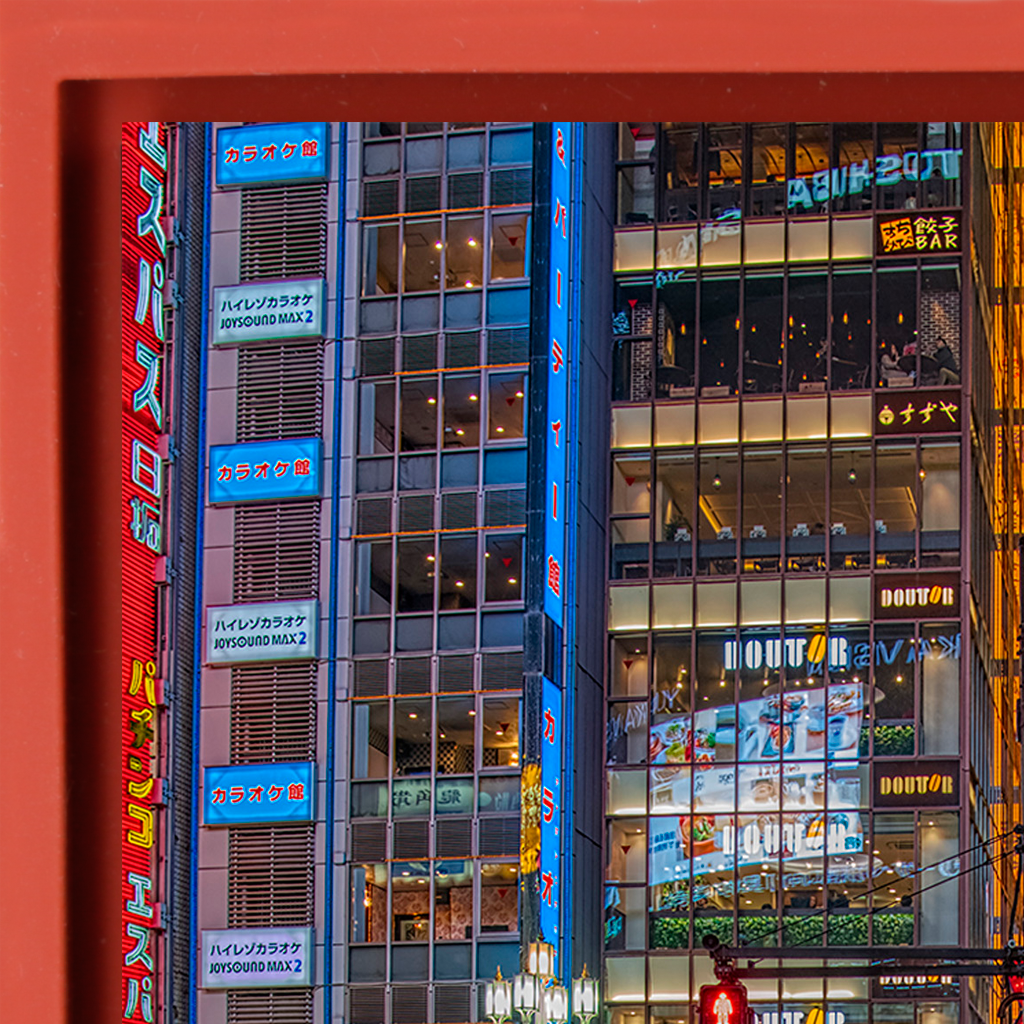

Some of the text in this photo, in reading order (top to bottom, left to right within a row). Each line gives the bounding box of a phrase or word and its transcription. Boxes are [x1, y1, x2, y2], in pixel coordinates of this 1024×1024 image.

[224, 140, 319, 164] カラオケ館
[913, 216, 959, 235] 餃子
[915, 233, 958, 250] BAR
[220, 294, 313, 312] ハイレゾカラオケ
[219, 313, 276, 330] JOYSOUND
[899, 401, 959, 425] すずや
[217, 458, 311, 482] カラオケ館
[880, 584, 954, 608] DOUTOR
[213, 614, 307, 632] ハイレゾカラオケ
[213, 634, 270, 651] JOYSOUND
[724, 633, 849, 671] DOUTOR
[127, 660, 156, 849] パチンコ
[211, 782, 305, 804] カラオケ館
[880, 772, 954, 795] DOUTOR
[209, 940, 303, 957] ハイレゾカラオケ
[208, 959, 266, 975] JOYSOUND
